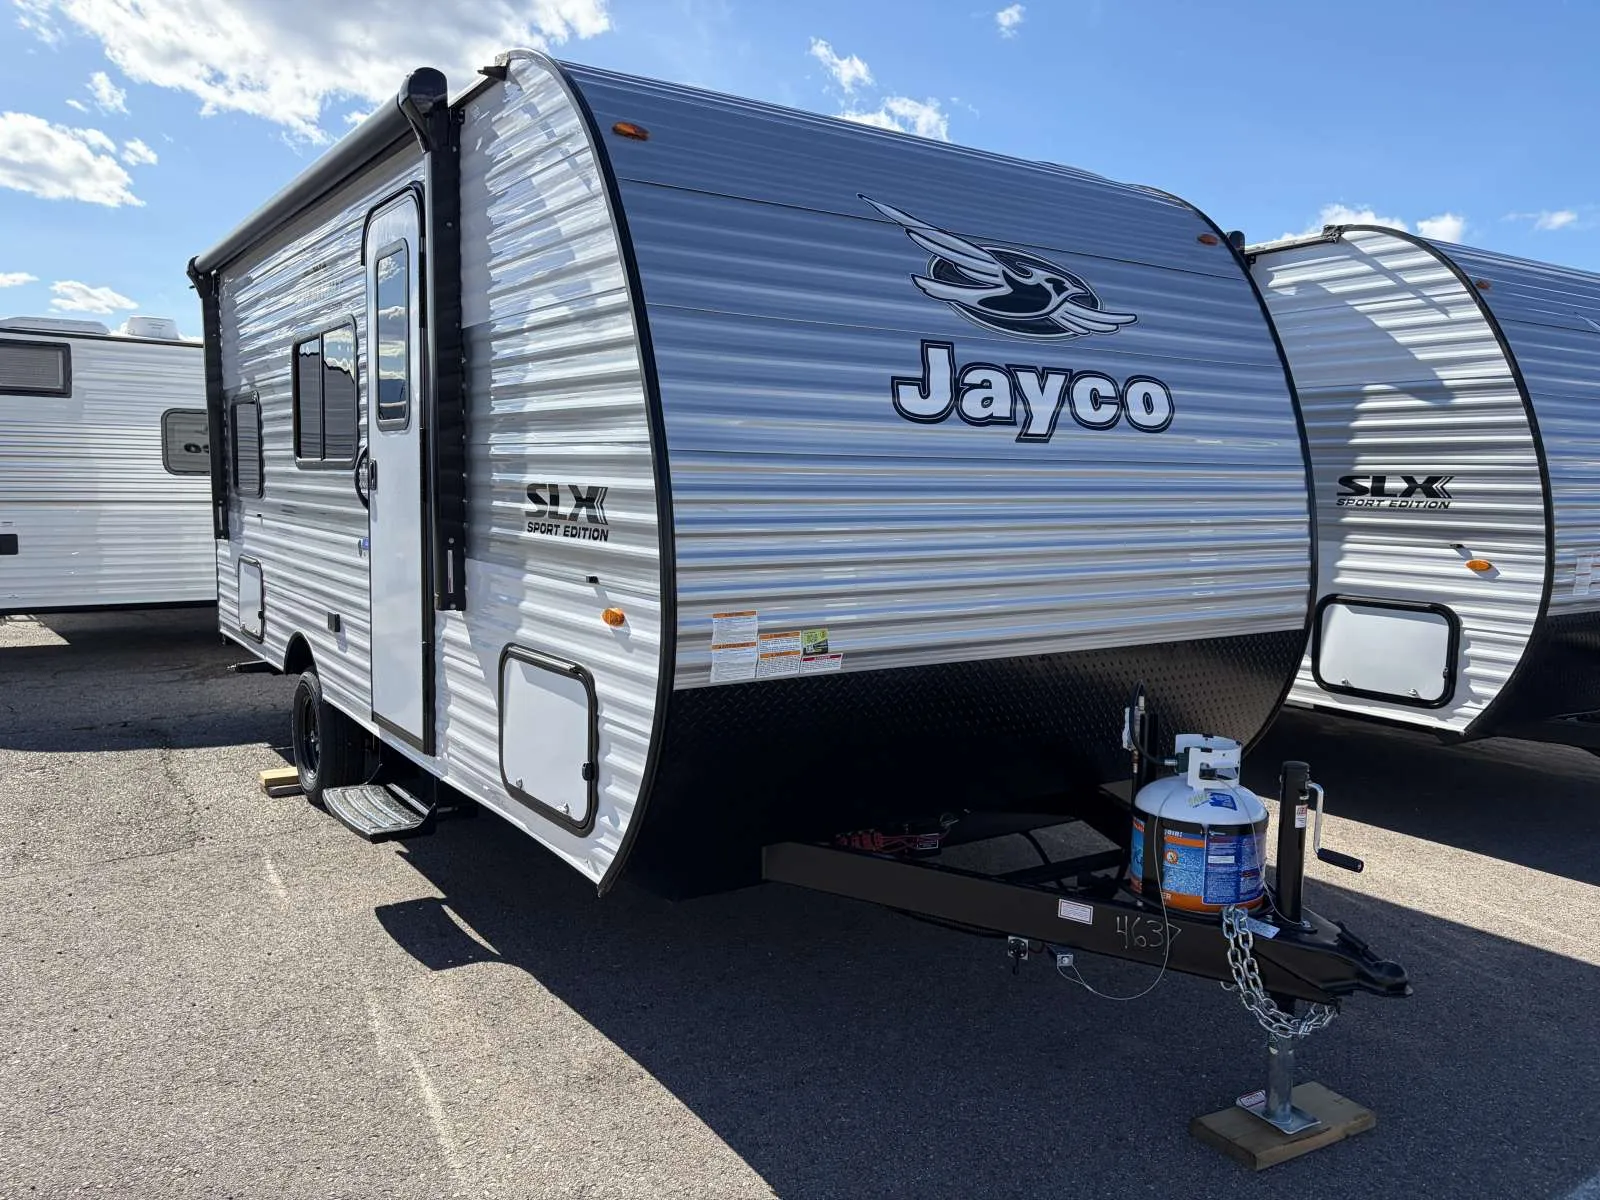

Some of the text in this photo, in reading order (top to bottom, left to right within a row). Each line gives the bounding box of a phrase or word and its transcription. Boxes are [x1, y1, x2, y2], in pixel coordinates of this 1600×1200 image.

[891, 339, 1176, 443] Jayco
[1336, 475, 1455, 499] SLX
[525, 482, 609, 526] SLX
[1336, 499, 1451, 510] SPORT EDITION
[527, 521, 609, 542] SPORT EDITION
